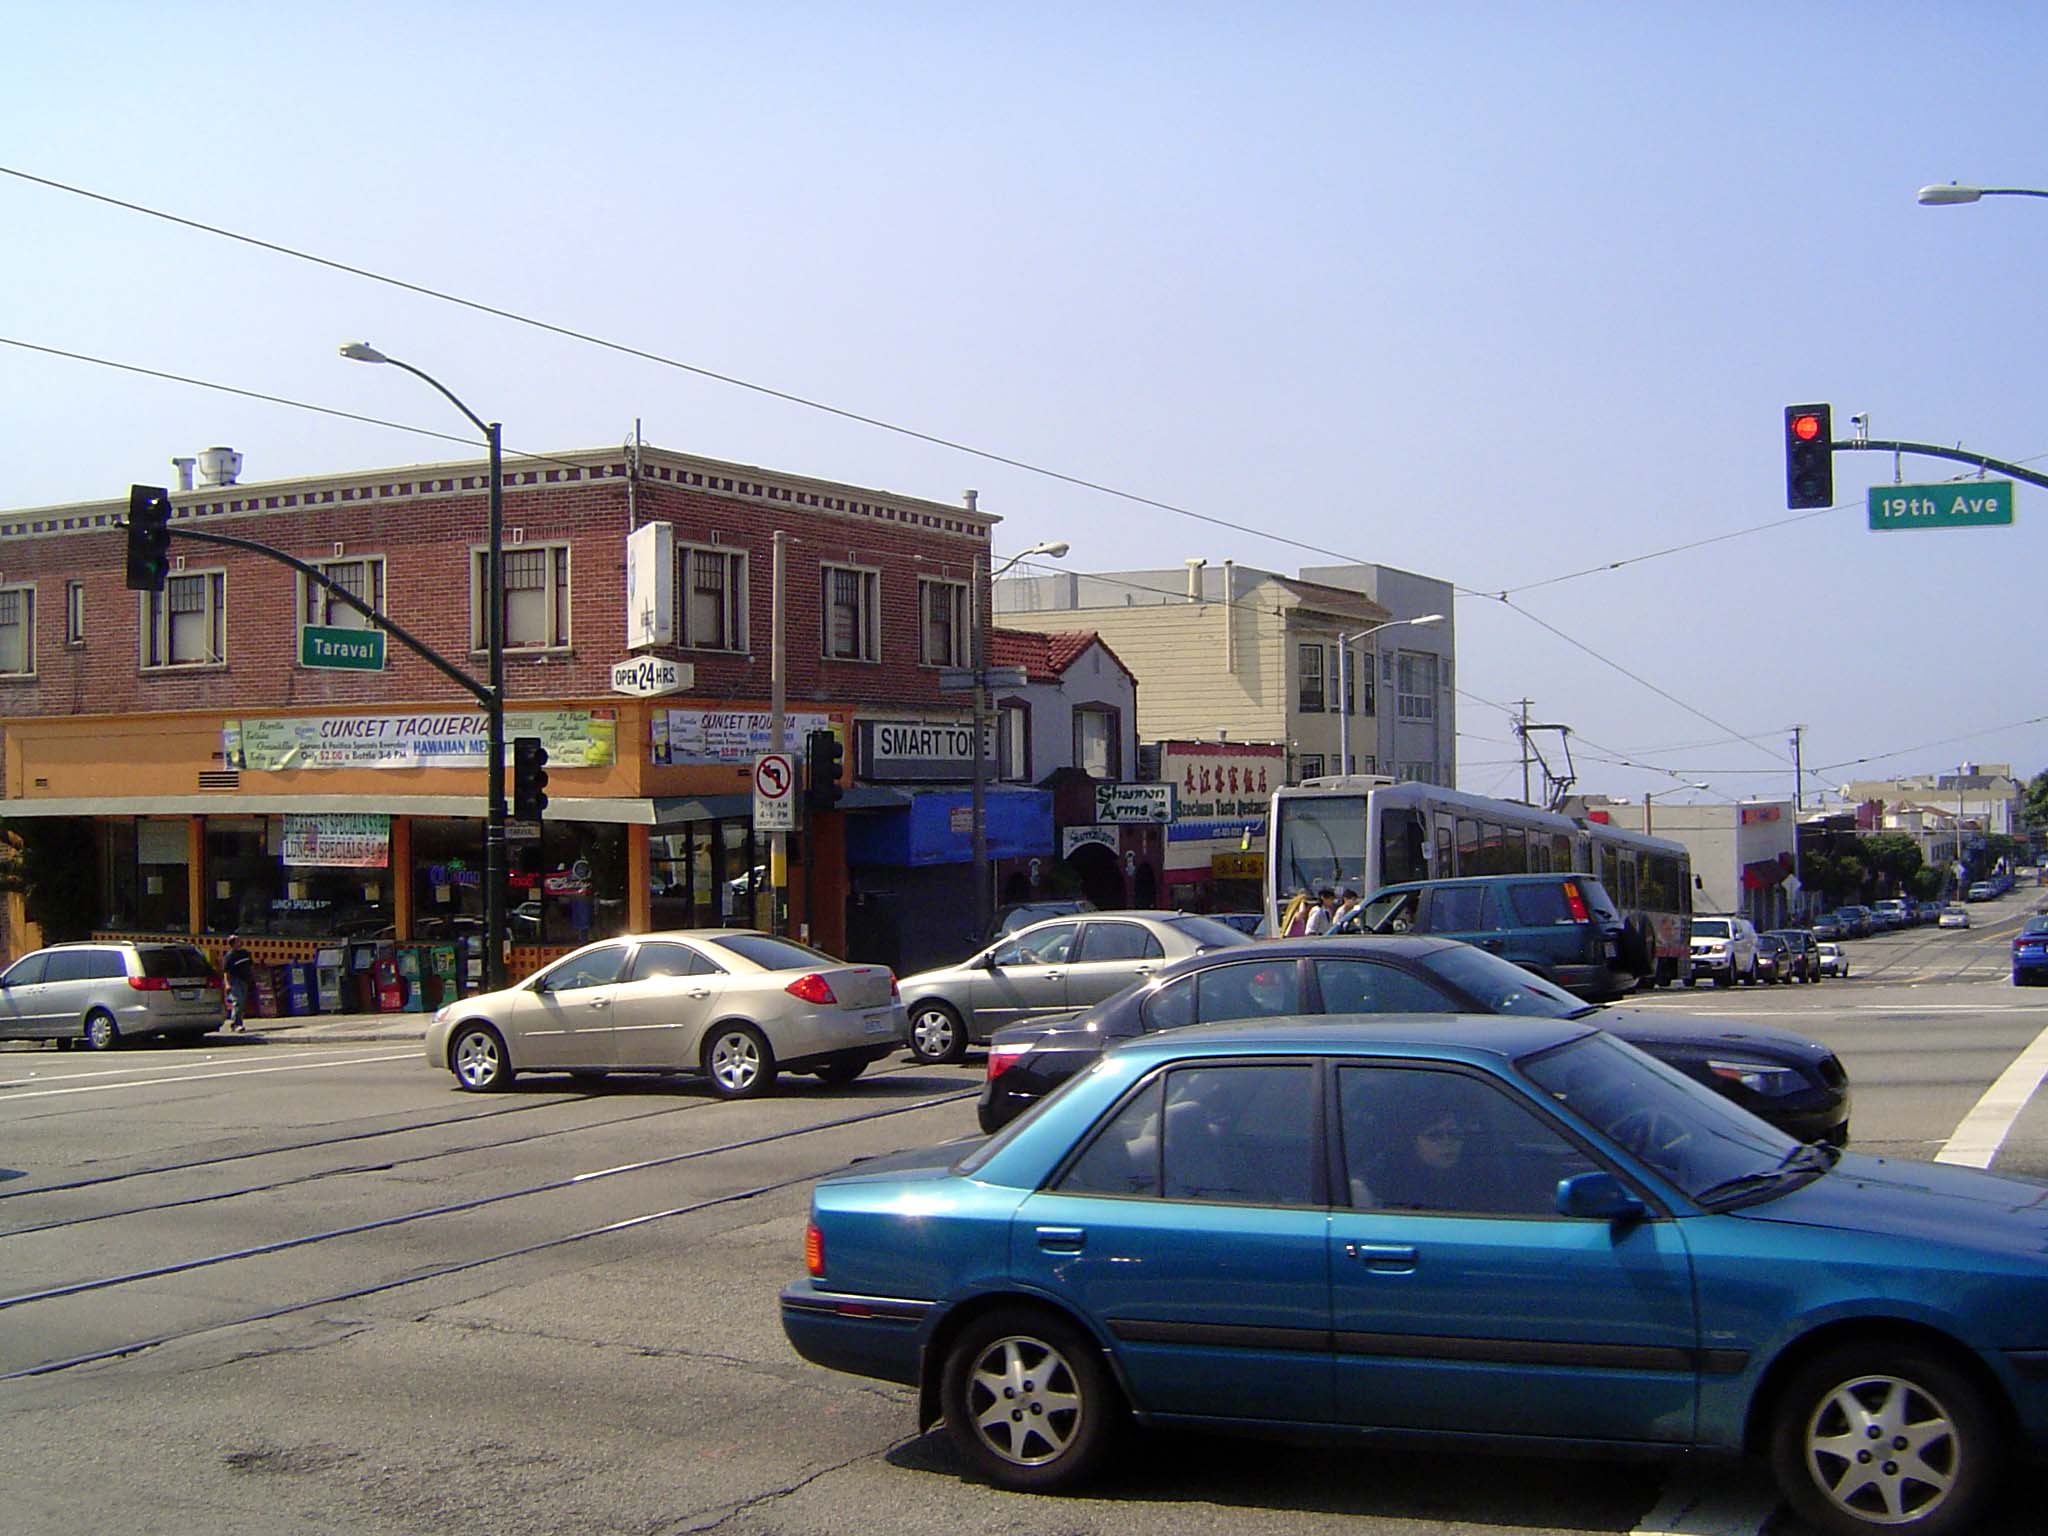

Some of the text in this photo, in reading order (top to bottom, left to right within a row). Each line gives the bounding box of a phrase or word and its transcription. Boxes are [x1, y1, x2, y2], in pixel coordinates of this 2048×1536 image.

[1882, 496, 1998, 518] 19th Ave
[314, 638, 375, 658] Taraval
[615, 667, 638, 686] OPEN
[638, 662, 656, 690] 24
[319, 718, 389, 738] SUNSET
[700, 714, 745, 730] SUNSET
[413, 739, 466, 754] HAWAIIAN
[881, 728, 942, 755] SMART
[1098, 784, 1165, 804] Shannon
[1100, 804, 1148, 820] Arms
[285, 841, 317, 858] LUNCH
[319, 841, 363, 859] SPECIALS
